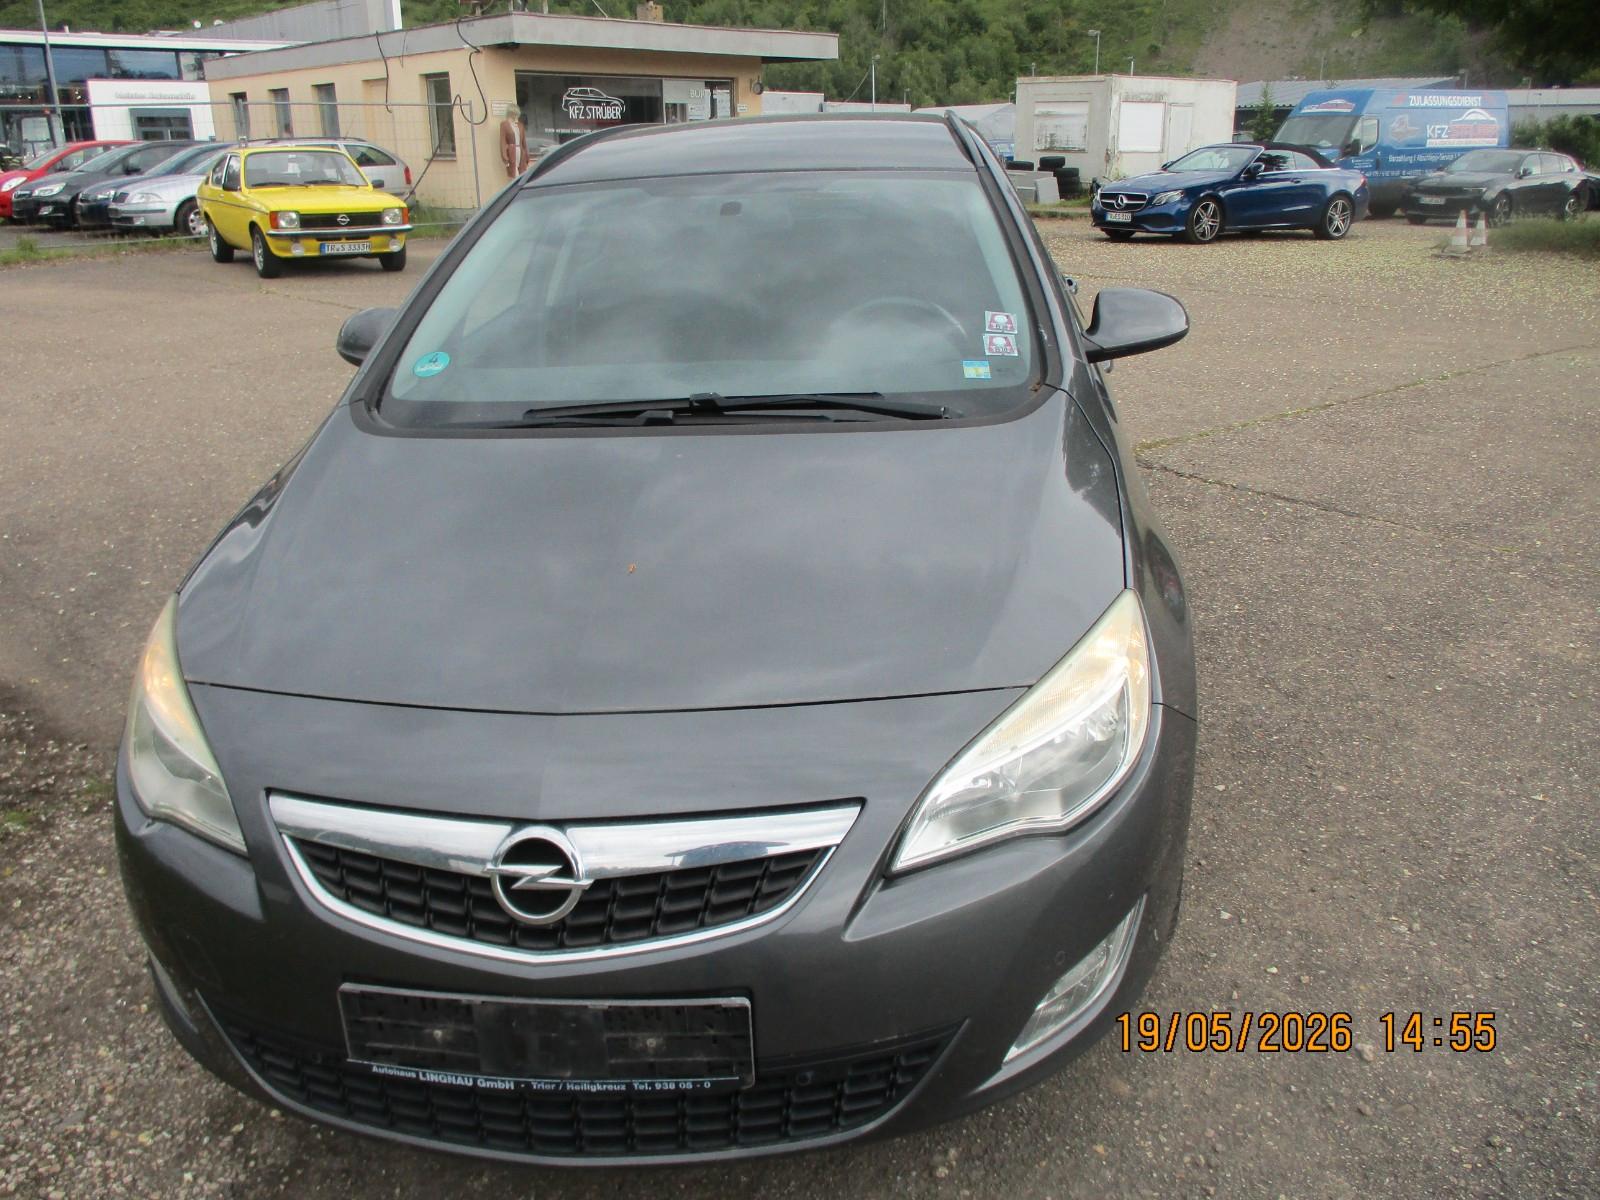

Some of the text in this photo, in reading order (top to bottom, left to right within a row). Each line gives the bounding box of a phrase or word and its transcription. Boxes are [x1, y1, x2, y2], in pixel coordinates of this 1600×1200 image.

[1409, 95, 1482, 107] ZULASSUNGSDIENST
[569, 103, 622, 119] KFZ STRÜBER
[372, 1065, 416, 1078] Autohaus
[477, 1078, 514, 1090] GmbH
[531, 1081, 556, 1090] Trier
[566, 1083, 626, 1092] Heiligkreuz
[632, 1081, 652, 1091] Tel.
